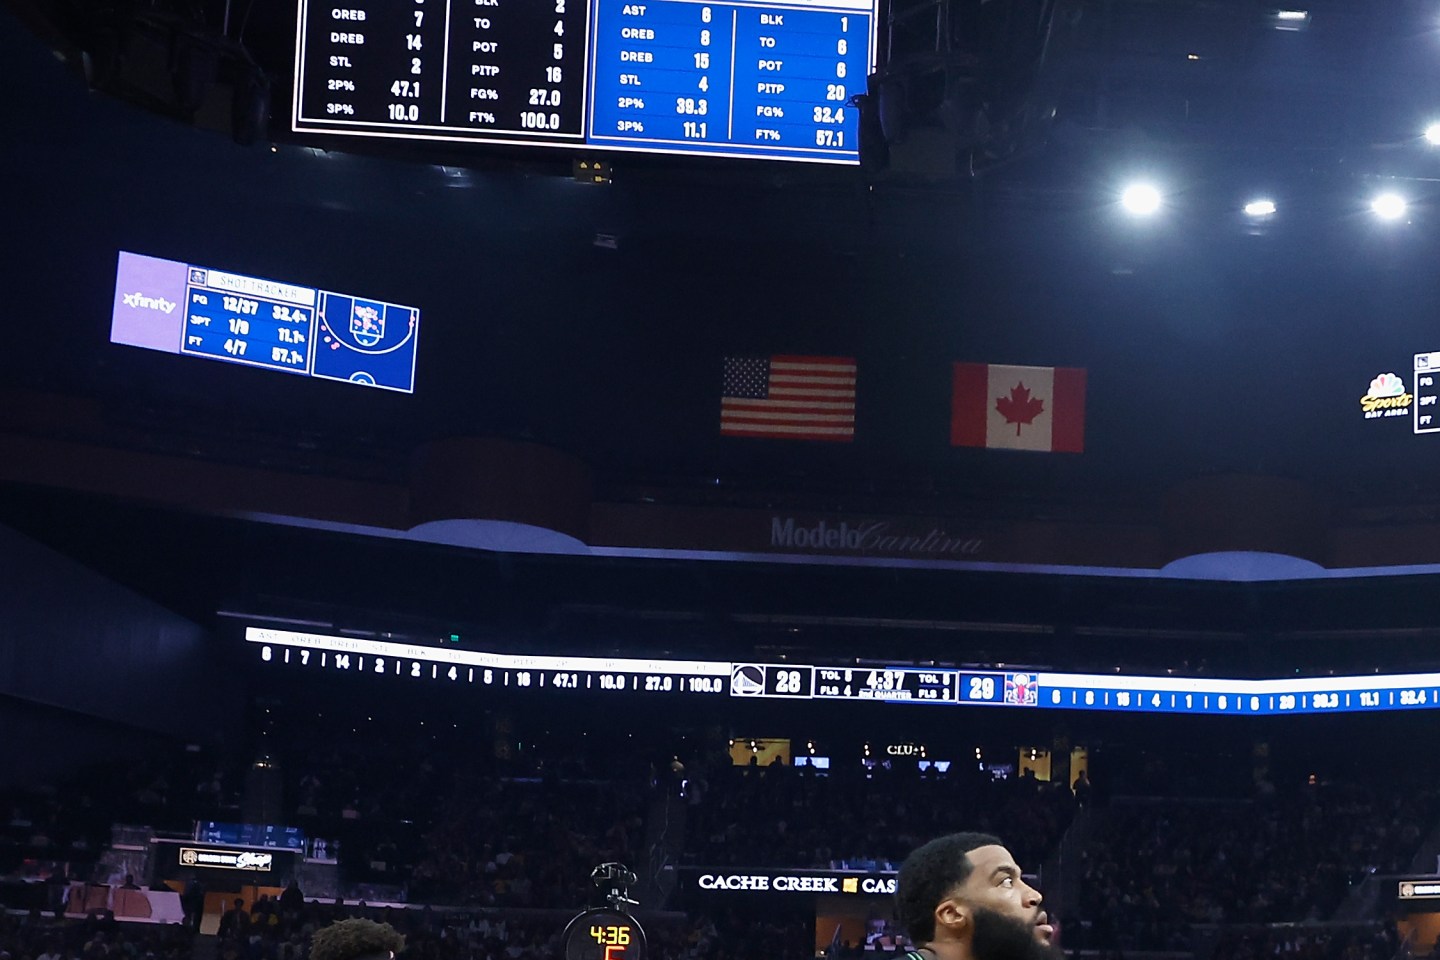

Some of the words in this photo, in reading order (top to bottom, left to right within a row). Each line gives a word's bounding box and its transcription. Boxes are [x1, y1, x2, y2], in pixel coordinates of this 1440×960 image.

[332, 8, 366, 21] OREB
[414, 11, 424, 27] 7
[623, 5, 646, 17] AST
[702, 7, 712, 23] 6
[474, 18, 491, 29] TO
[554, 20, 564, 36] 4
[760, 14, 784, 26] BLK
[841, 16, 848, 33] 1
[330, 32, 364, 45] DREB
[406, 34, 423, 50] 14
[622, 28, 655, 40] OREB
[701, 29, 710, 46] 8
[759, 37, 776, 48] TO
[473, 41, 498, 53] POT
[553, 44, 563, 60] 5
[329, 56, 352, 68] STL
[410, 58, 422, 74] 2
[620, 51, 653, 63] DREB
[694, 53, 710, 69] 15
[758, 60, 783, 71] POT
[471, 65, 500, 76] PITP
[546, 66, 562, 83] 16
[620, 74, 641, 86] STL
[698, 76, 709, 92] 4
[327, 79, 355, 91] 2P%
[390, 81, 420, 98] 47.1
[470, 88, 499, 100] FG%
[529, 89, 561, 107] 27.0
[757, 83, 785, 95] PITP
[826, 84, 846, 101] 20
[326, 103, 354, 115] 3P%
[388, 104, 419, 121] 10.0
[618, 97, 645, 109] 2P%
[676, 98, 708, 115] 39.3
[756, 106, 784, 118] FG%
[813, 106, 845, 124] 32.4
[470, 111, 495, 124] FT%
[520, 112, 560, 129] 100.0
[617, 120, 644, 132] 3P%
[683, 122, 707, 139] 11.1
[755, 129, 781, 141] FT%
[815, 130, 844, 147] 57.1
[122, 292, 176, 314] xfinity
[222, 296, 258, 316] 12/37
[188, 336, 203, 347] FT
[223, 339, 248, 356] 4/7
[1360, 393, 1413, 412] Sports
[1419, 415, 1432, 425] FT
[771, 517, 861, 549] Modelo
[300, 650, 310, 665] 7
[335, 654, 350, 670] 14
[375, 658, 385, 674] 2
[411, 661, 421, 677] 2
[448, 665, 457, 681] 4
[552, 673, 578, 689] 47.1
[599, 674, 625, 690] 10.0
[644, 676, 672, 692] 27.0
[688, 677, 723, 693] 100.0
[820, 671, 841, 681] TOL
[866, 671, 905, 690] 4:37
[918, 674, 939, 684] TOL
[775, 670, 801, 693] 28
[969, 678, 994, 700] 29
[820, 686, 839, 696] FLS
[843, 685, 852, 697] 4
[918, 689, 937, 699] FLS
[1152, 693, 1161, 707] 4
[1185, 694, 1193, 709] 1
[1360, 692, 1380, 706] 11.1
[887, 745, 919, 756] CLU
[699, 875, 768, 890] CACHE
[773, 876, 838, 892] CREEK
[591, 926, 630, 945] 4:36
